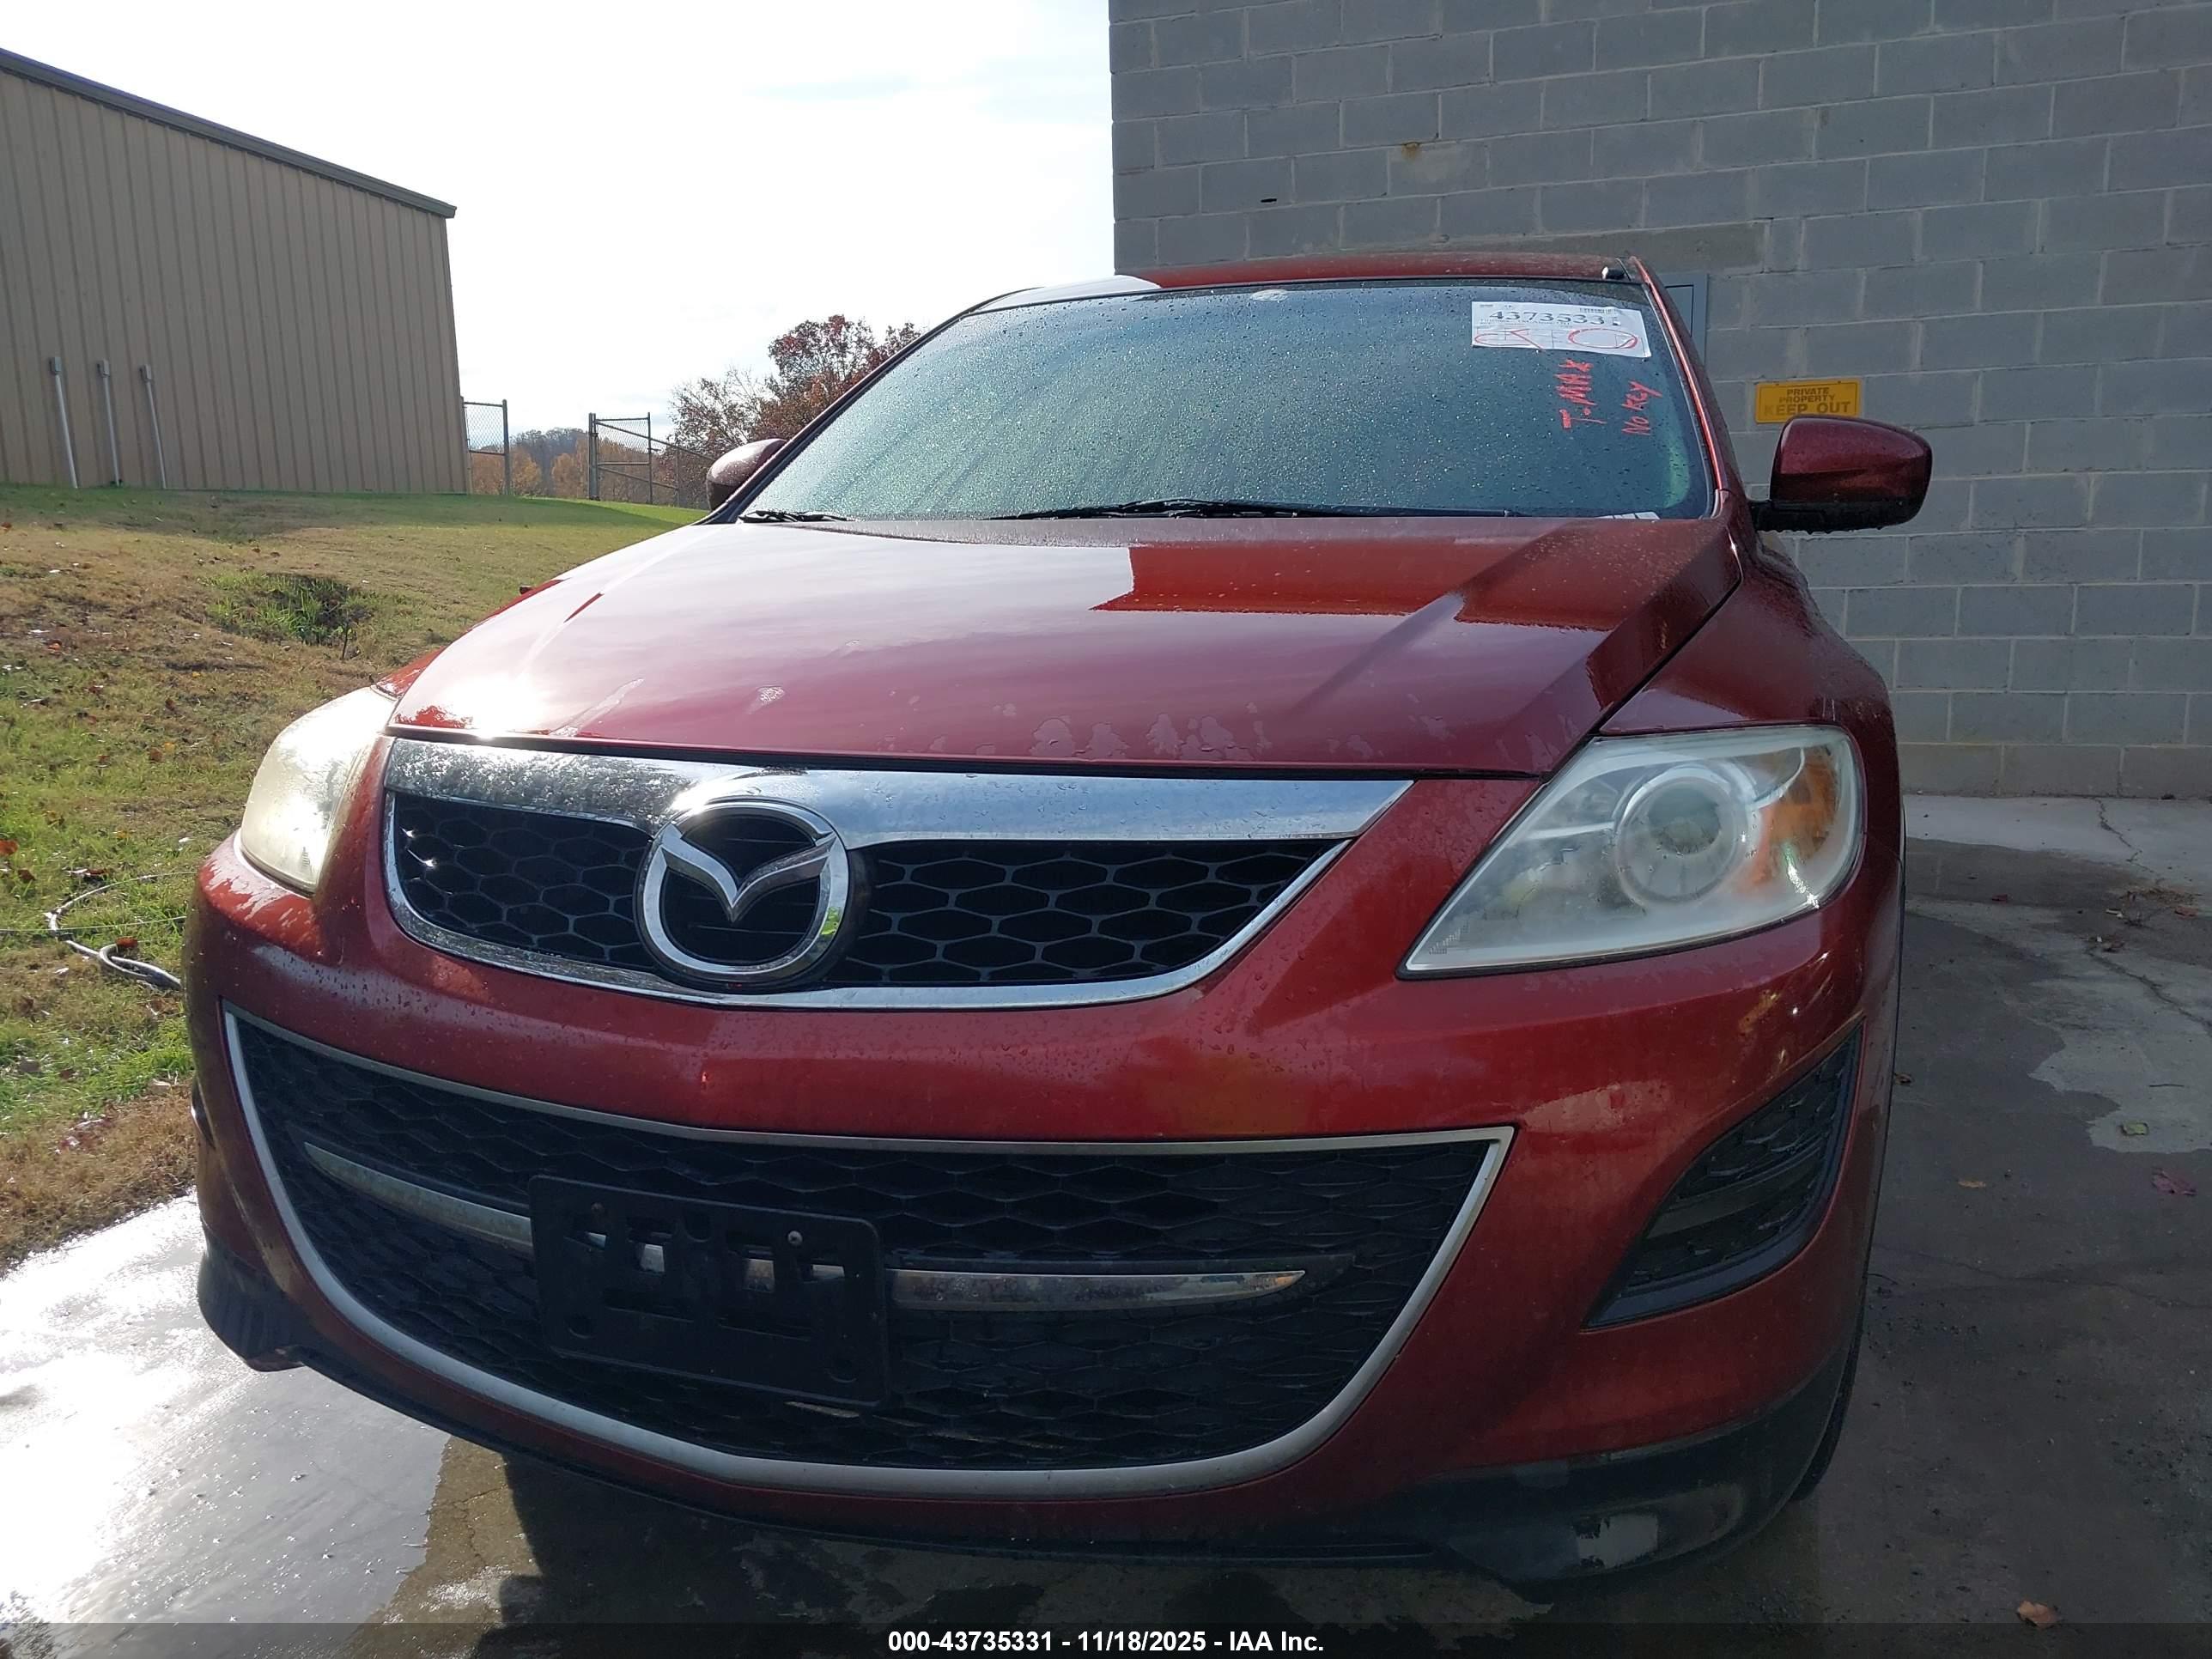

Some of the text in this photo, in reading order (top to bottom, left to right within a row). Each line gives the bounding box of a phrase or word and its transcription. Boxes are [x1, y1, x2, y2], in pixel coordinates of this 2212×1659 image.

[1787, 386, 1830, 396] PRIVATE
[1778, 394, 1835, 404] PROPERTY
[1764, 401, 1851, 416] KEEP OUT
